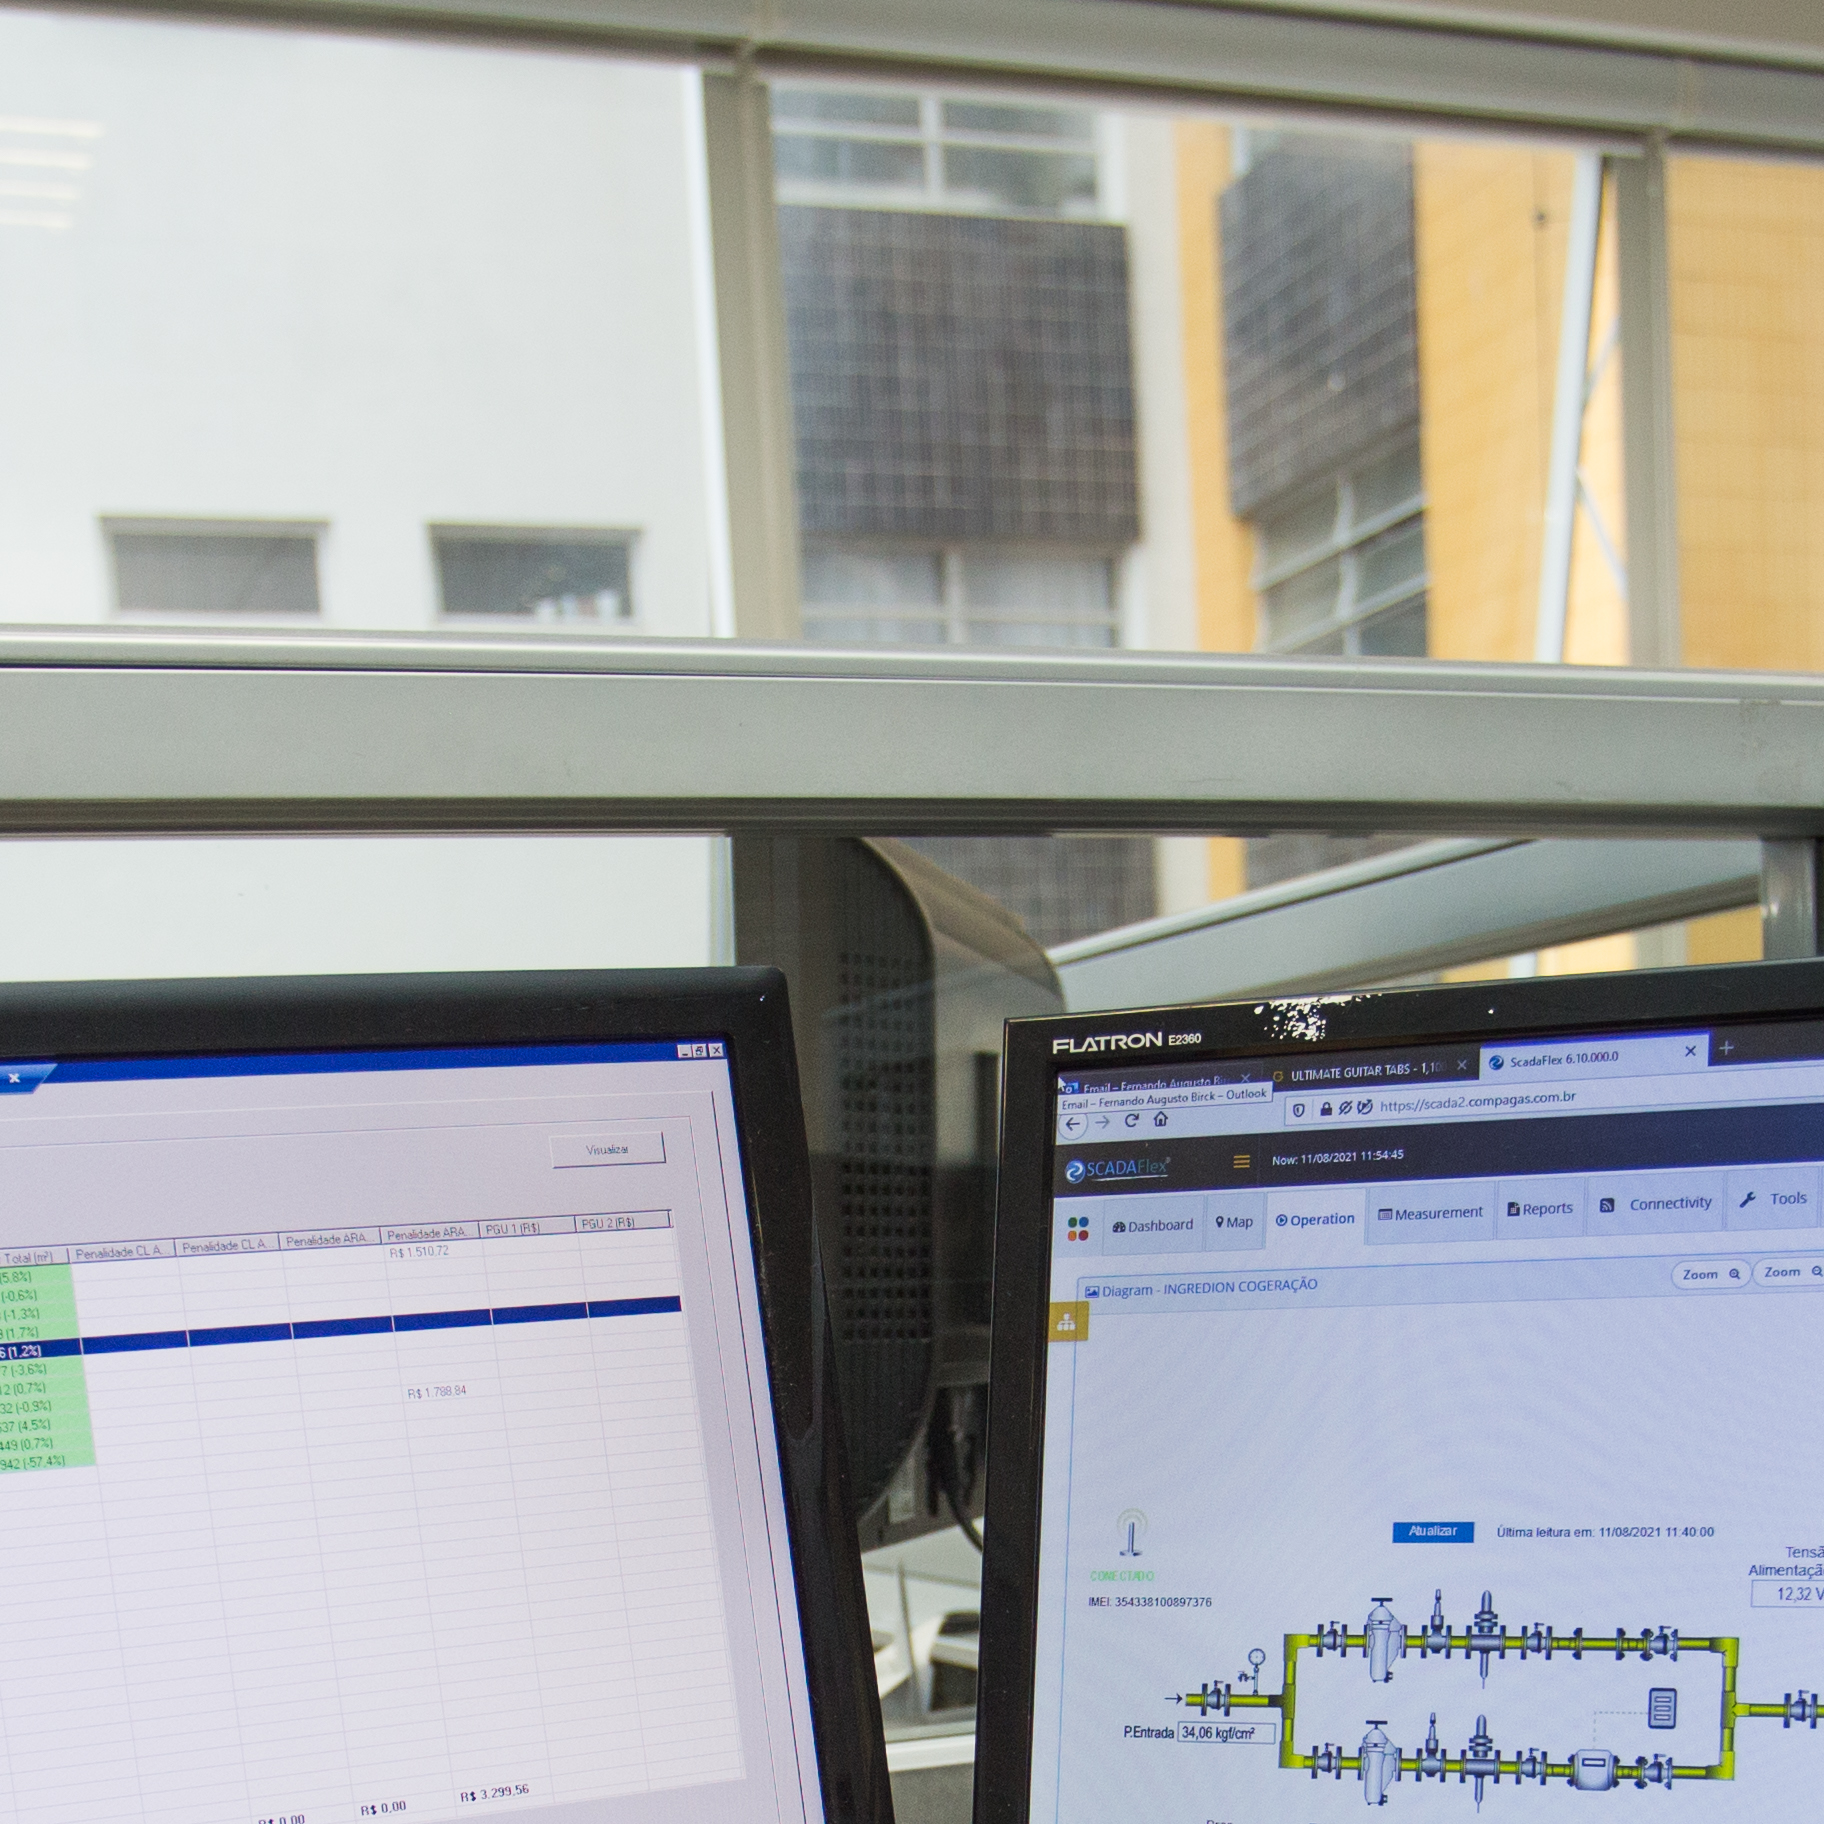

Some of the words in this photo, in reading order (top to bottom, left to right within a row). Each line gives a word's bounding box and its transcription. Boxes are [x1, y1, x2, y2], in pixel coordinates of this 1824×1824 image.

[1052, 1032, 1162, 1054] FLATRON
[1168, 1034, 1201, 1046] E2360
[1510, 1055, 1562, 1068] ScadaFlex
[1566, 1051, 1619, 1065] 6.10.000.0
[1292, 1067, 1341, 1082] ULTIMATE
[1344, 1066, 1381, 1079] GUITAR
[1385, 1064, 1410, 1077] TABS
[1062, 1100, 1088, 1111] Email
[1099, 1095, 1148, 1107] Fernando
[1151, 1093, 1188, 1106] Augusto
[1190, 1091, 1216, 1102] Birck
[1226, 1088, 1267, 1100] Outlook
[1381, 1091, 1576, 1113] https://scada2.compagas.com.br
[1272, 1155, 1297, 1167] Now:
[1301, 1150, 1357, 1164] 11/08/2021
[1361, 1149, 1404, 1161] 11:54:45
[1631, 1196, 1712, 1214] Connectivity
[1771, 1191, 1807, 1205] Tools
[1396, 1205, 1483, 1221] Measurement
[1523, 1201, 1573, 1216] Reports
[1128, 1218, 1193, 1234] Dashboard
[1226, 1216, 1253, 1230] Map
[1291, 1212, 1355, 1228] Operation
[1683, 1270, 1718, 1281] Zoom
[1765, 1267, 1800, 1278] Zoom
[1103, 1283, 1153, 1301] Diagram
[1164, 1280, 1234, 1295] INGREDION
[1238, 1276, 1318, 1295] COGERAÇÃO
[1409, 1525, 1457, 1537] Atualizar
[1497, 1524, 1532, 1538] Última
[1537, 1526, 1571, 1538] leitura
[1575, 1529, 1595, 1538] em:
[1599, 1526, 1661, 1539] 11/08/2021
[1665, 1526, 1714, 1538] 11:40:00
[1777, 1586, 1812, 1603] 12,32
[1124, 1725, 1174, 1739] P.Entrada
[1182, 1725, 1212, 1741] 34,06
